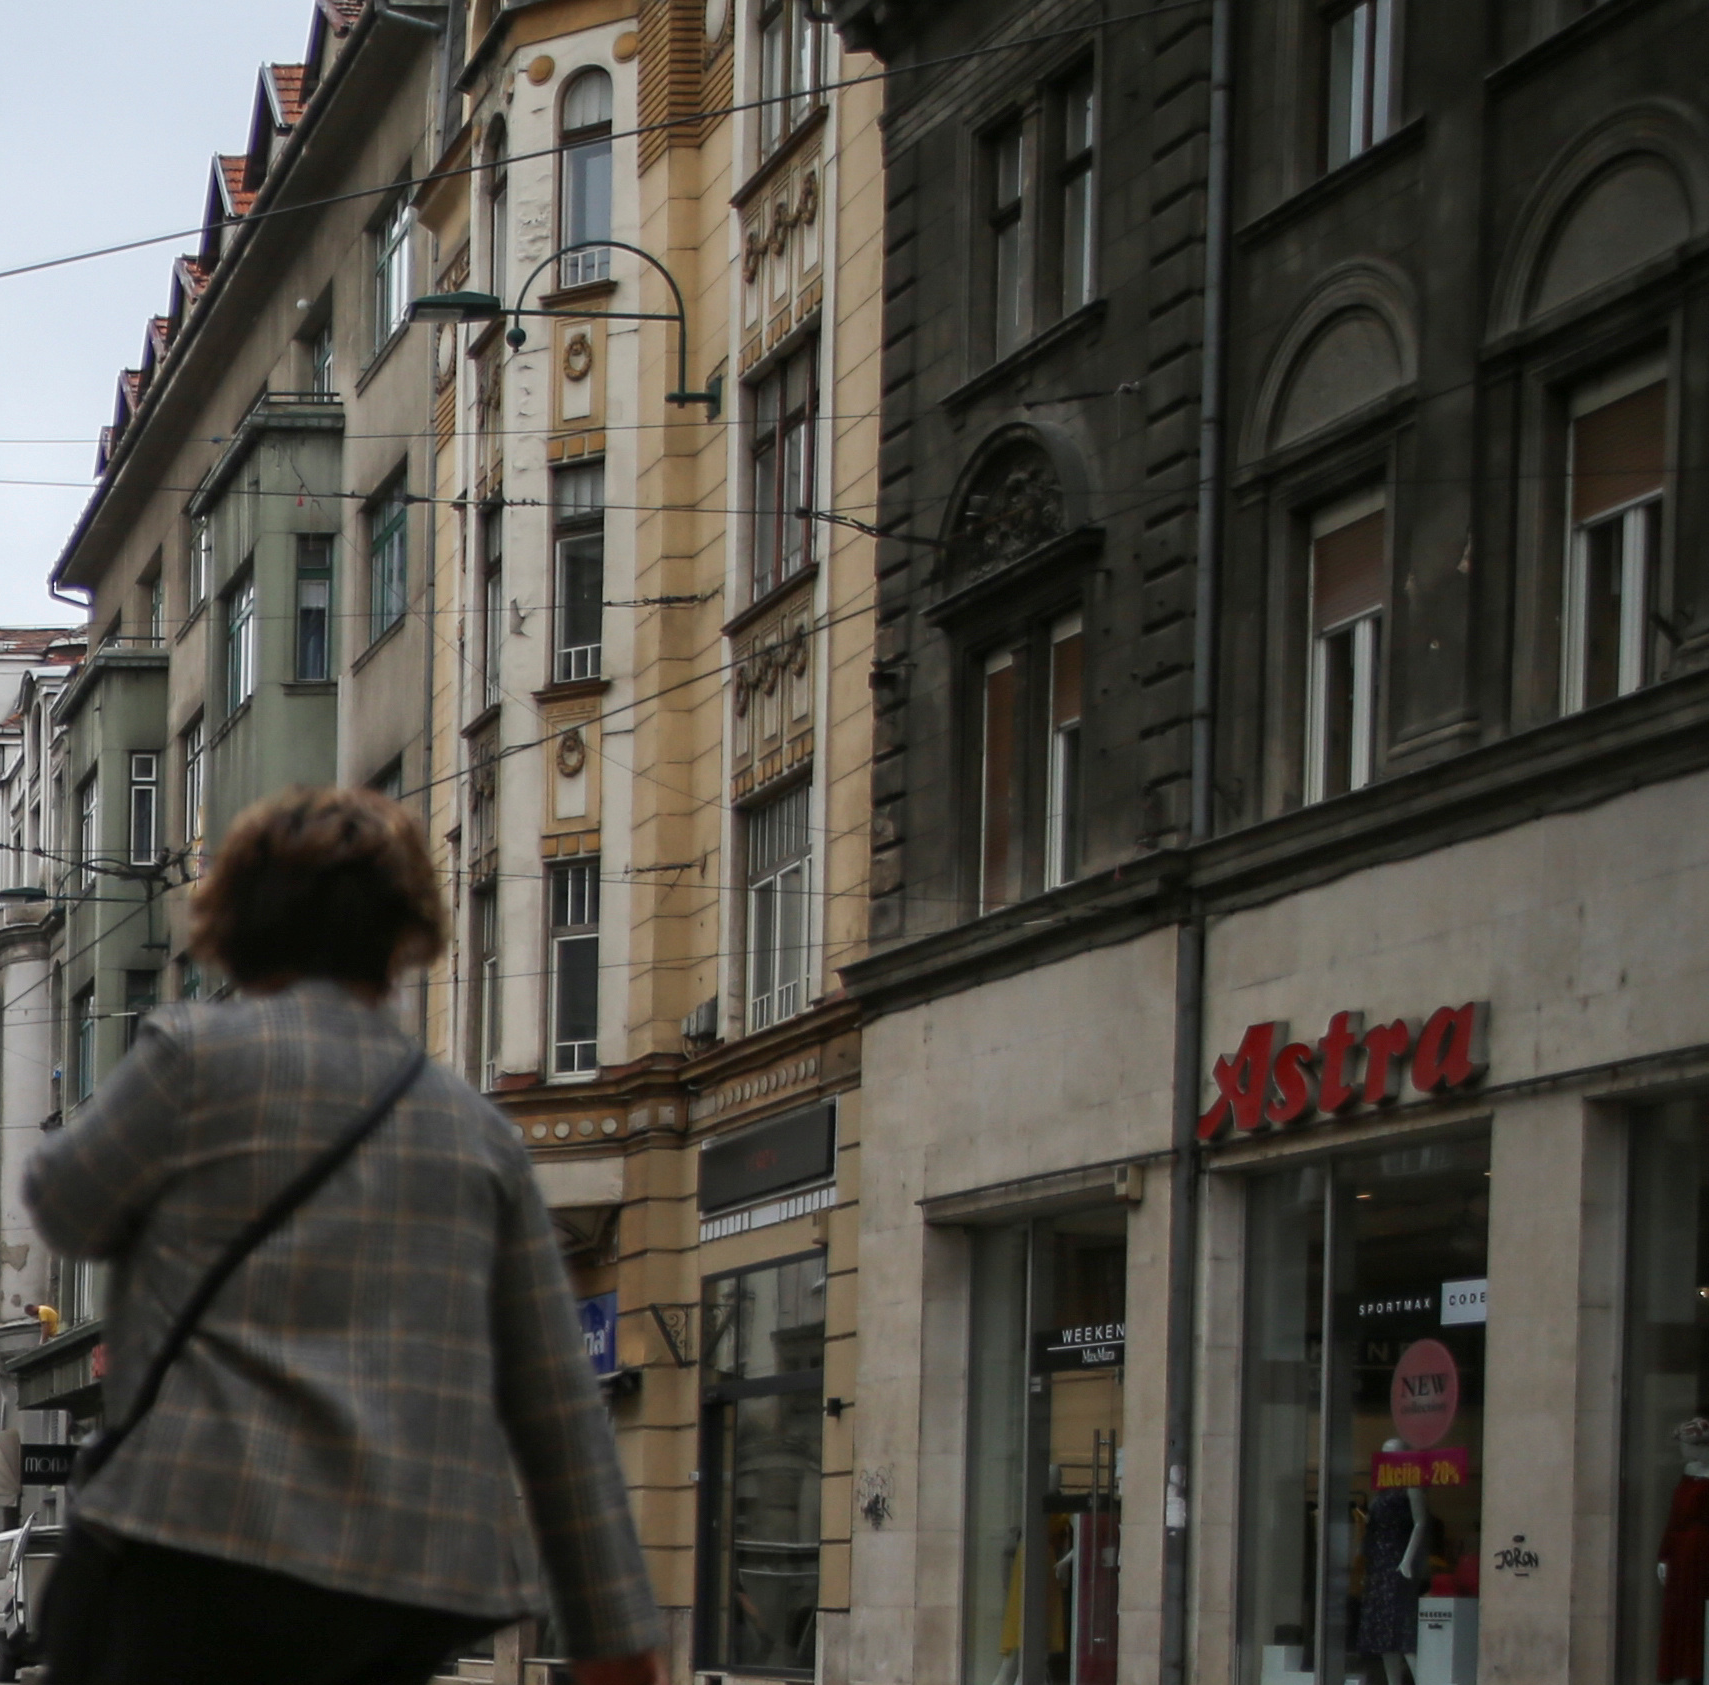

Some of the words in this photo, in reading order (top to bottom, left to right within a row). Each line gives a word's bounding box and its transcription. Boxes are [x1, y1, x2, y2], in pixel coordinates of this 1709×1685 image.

[1196, 1001, 1481, 1141] Astra
[1358, 1296, 1432, 1317] SPORTMAX
[1448, 1292, 1487, 1307] CODE
[1401, 1373, 1448, 1398] NEW
